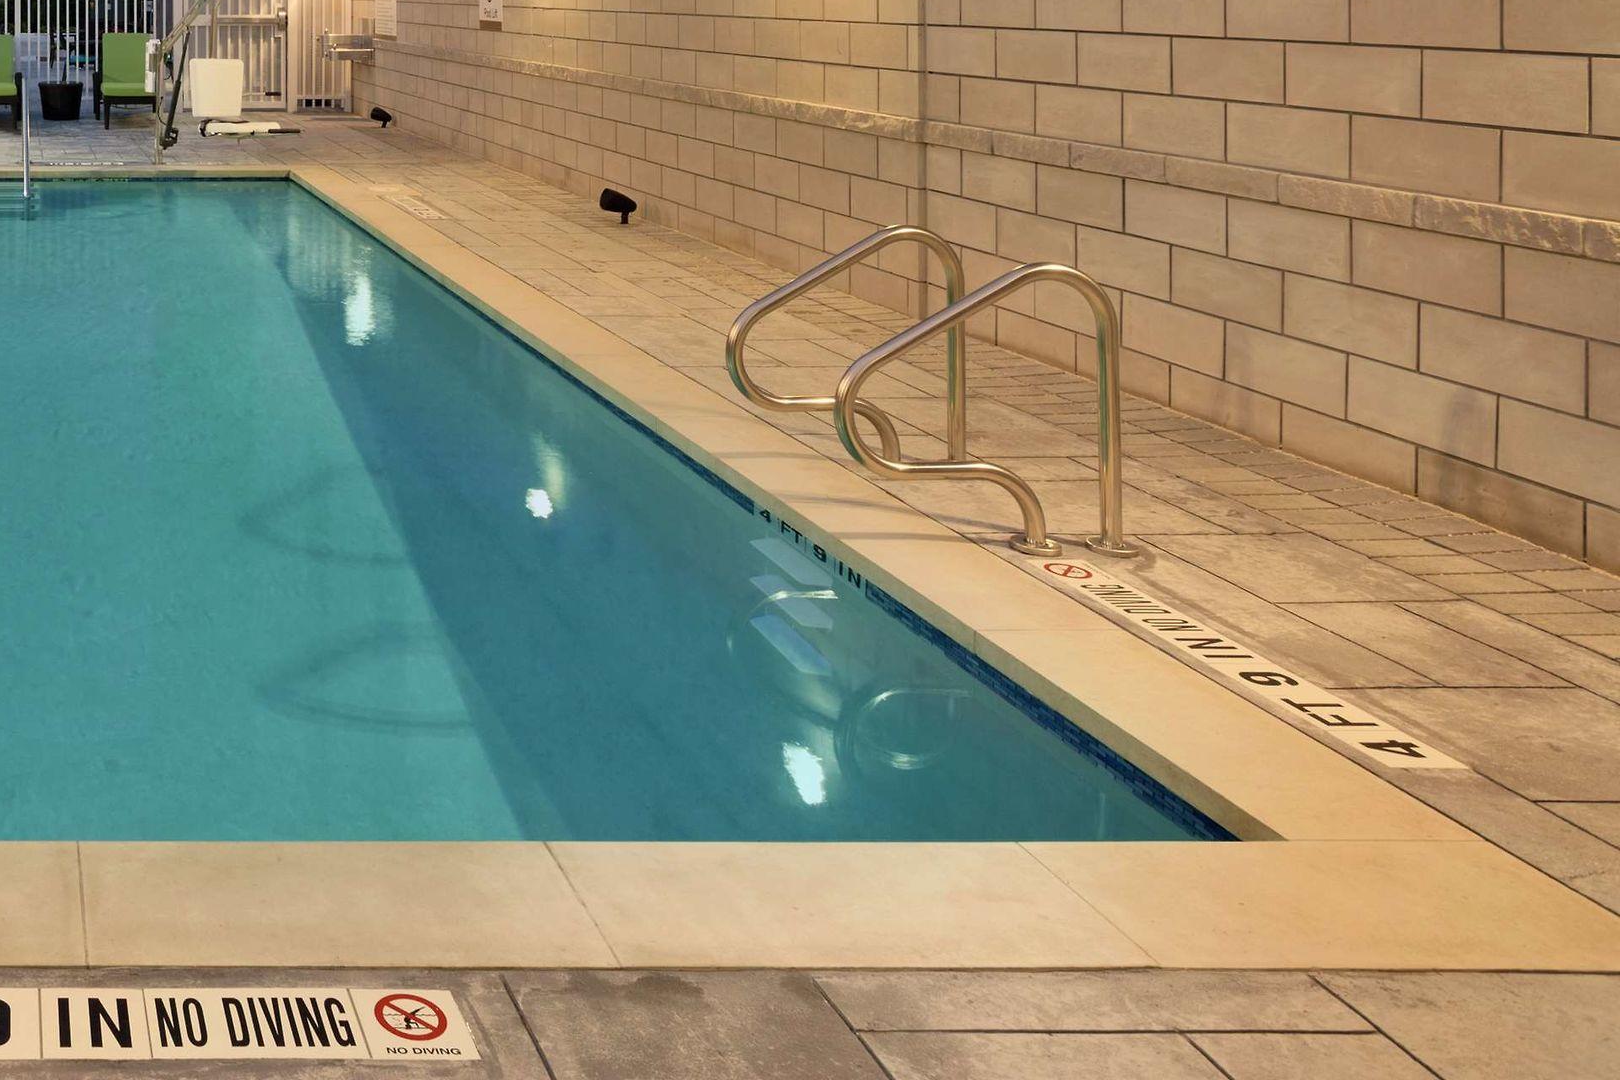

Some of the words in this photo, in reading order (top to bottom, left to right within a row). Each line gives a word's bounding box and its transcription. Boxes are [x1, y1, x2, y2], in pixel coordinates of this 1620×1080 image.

[759, 509, 771, 523] 4
[780, 520, 802, 543] FT
[813, 543, 826, 562] 9
[839, 561, 861, 588] IN
[1080, 584, 1172, 614] DIVING
[1142, 618, 1204, 631] NO
[1174, 637, 1254, 659] IN
[1238, 671, 1299, 687] 9
[1280, 697, 1379, 727] FT
[1360, 739, 1427, 759] 4
[58, 997, 133, 1047] IN
[154, 997, 208, 1047] NO
[222, 997, 356, 1047] DIVING
[386, 1047, 408, 1055] NO
[412, 1047, 462, 1056] DIVING
